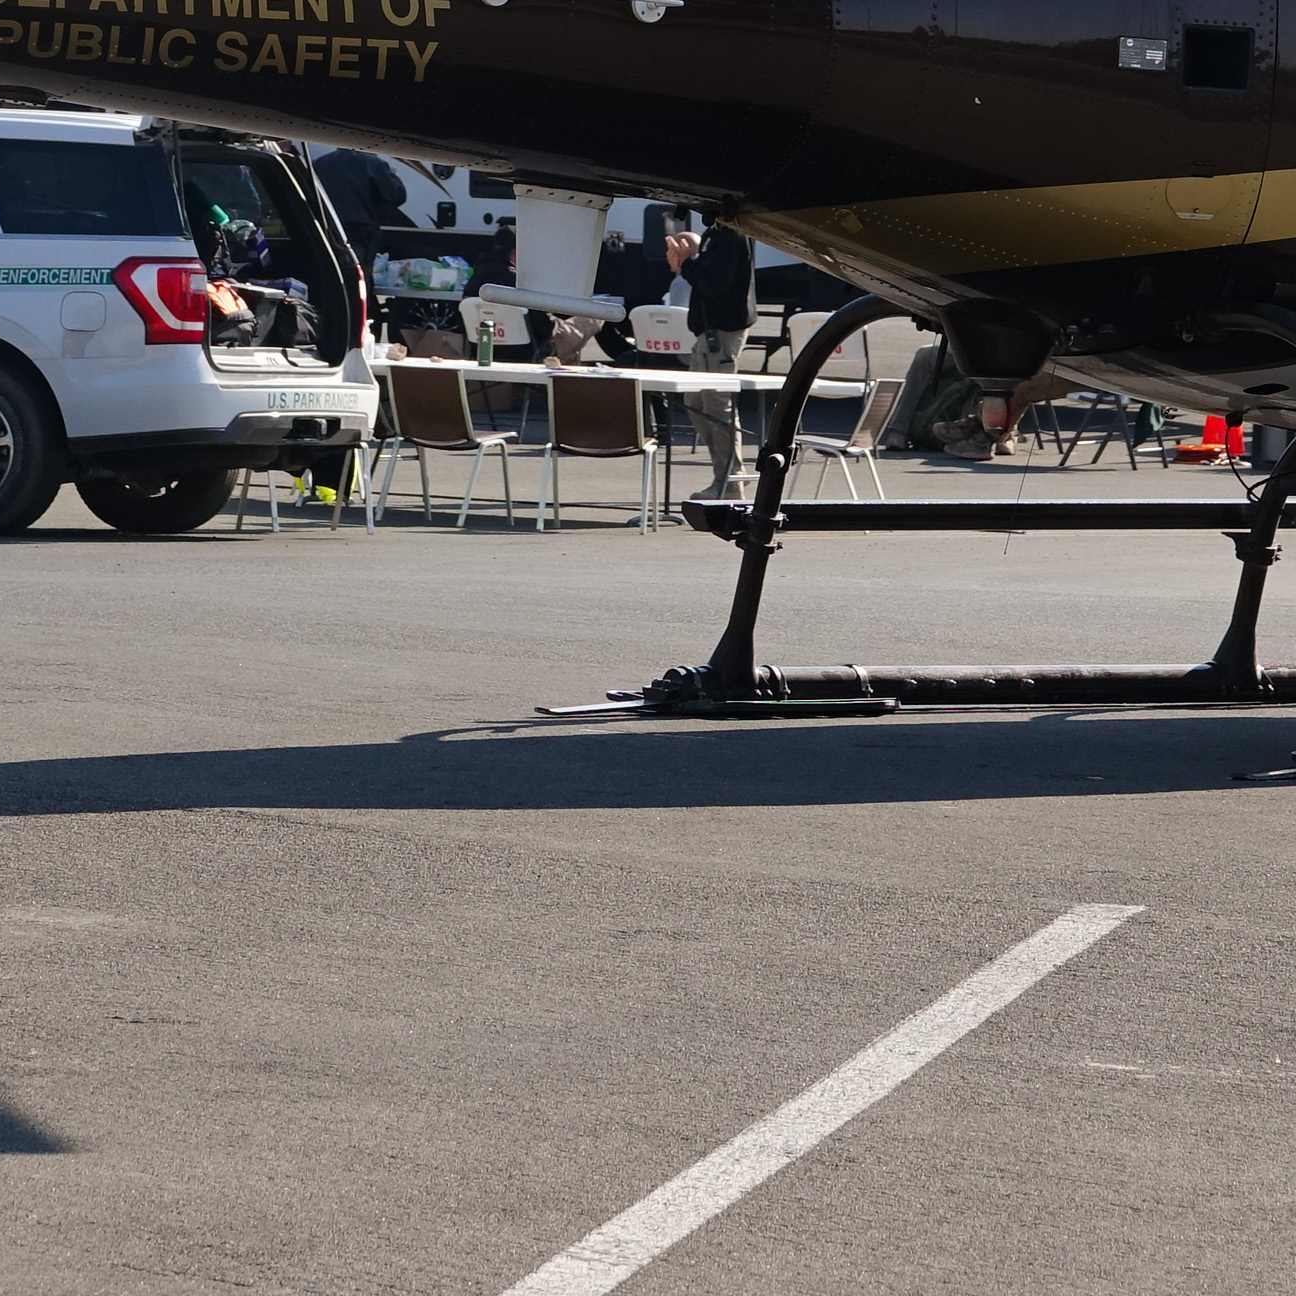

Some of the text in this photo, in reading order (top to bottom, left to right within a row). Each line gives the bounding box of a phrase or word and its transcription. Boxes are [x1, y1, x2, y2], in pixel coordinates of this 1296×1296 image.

[213, 30, 439, 82] SAFETY
[645, 340, 681, 351] GCSO
[267, 392, 359, 410] U.S. PARK RANGER
